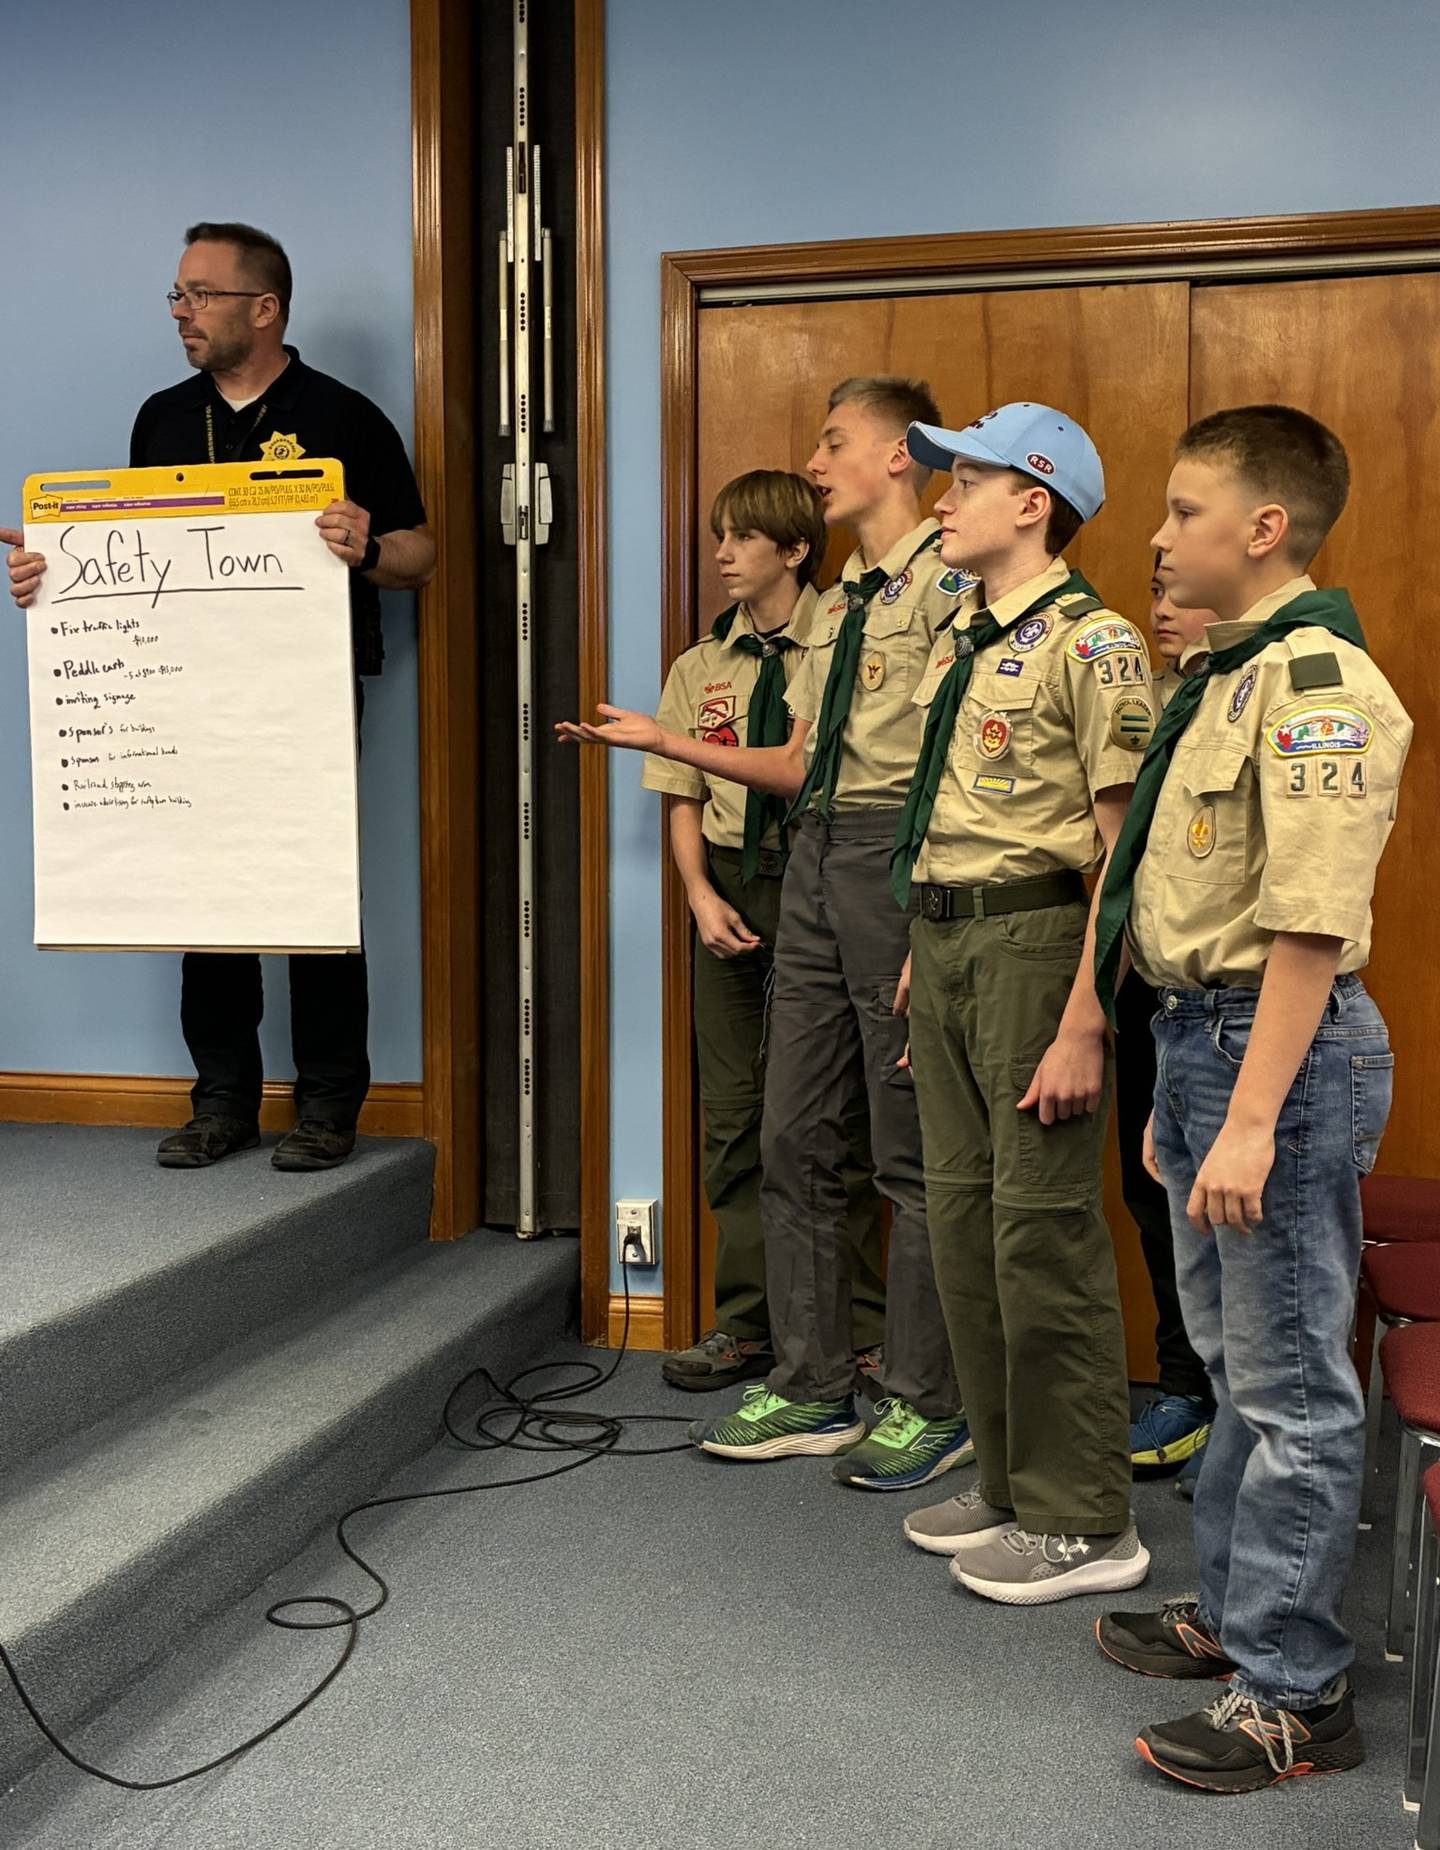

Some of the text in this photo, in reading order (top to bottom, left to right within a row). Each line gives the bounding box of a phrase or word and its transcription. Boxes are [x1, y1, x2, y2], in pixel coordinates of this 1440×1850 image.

[1029, 455, 1052, 473] RSR
[33, 502, 59, 511] Post-it
[59, 525, 283, 608] Safety Town
[60, 621, 80, 637] Fix
[115, 618, 140, 633] lights
[63, 659, 100, 680] Peddle
[1098, 656, 1144, 685] 324
[65, 691, 101, 709] inviting
[1311, 742, 1342, 750] ILLINOIS
